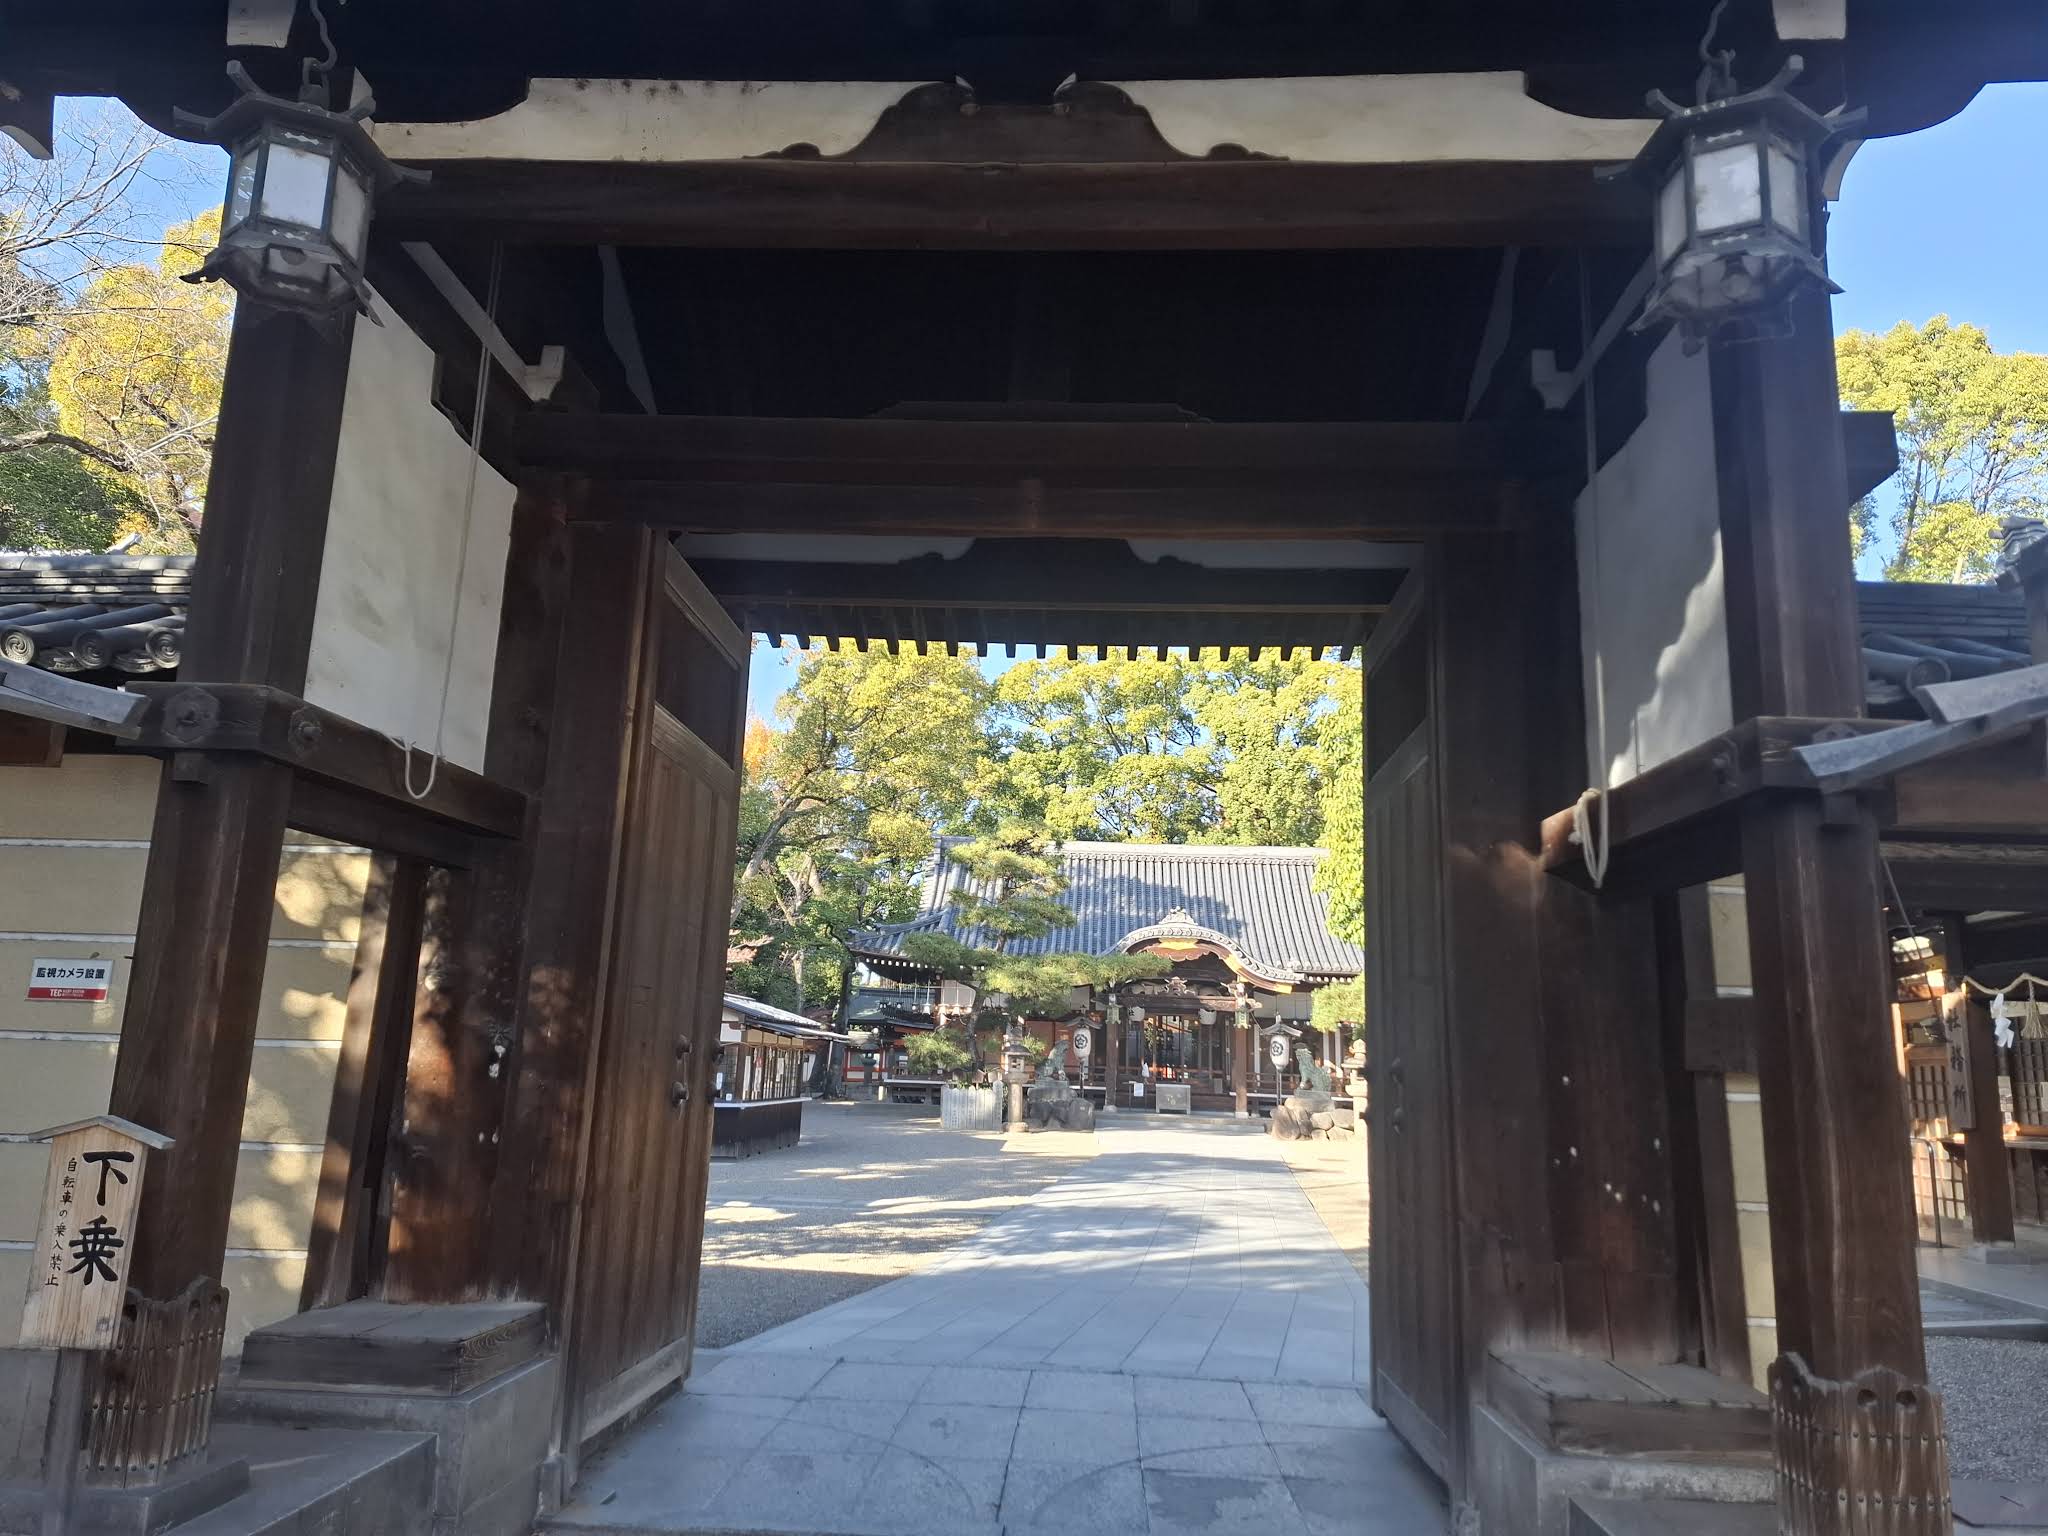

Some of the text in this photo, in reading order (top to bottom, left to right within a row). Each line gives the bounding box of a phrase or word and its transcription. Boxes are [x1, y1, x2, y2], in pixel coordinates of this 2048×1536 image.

[36, 967, 105, 979] 監視カメラ設置
[45, 1157, 77, 1286] 自転車の乗入禁止
[65, 1151, 135, 1286] 下乗
